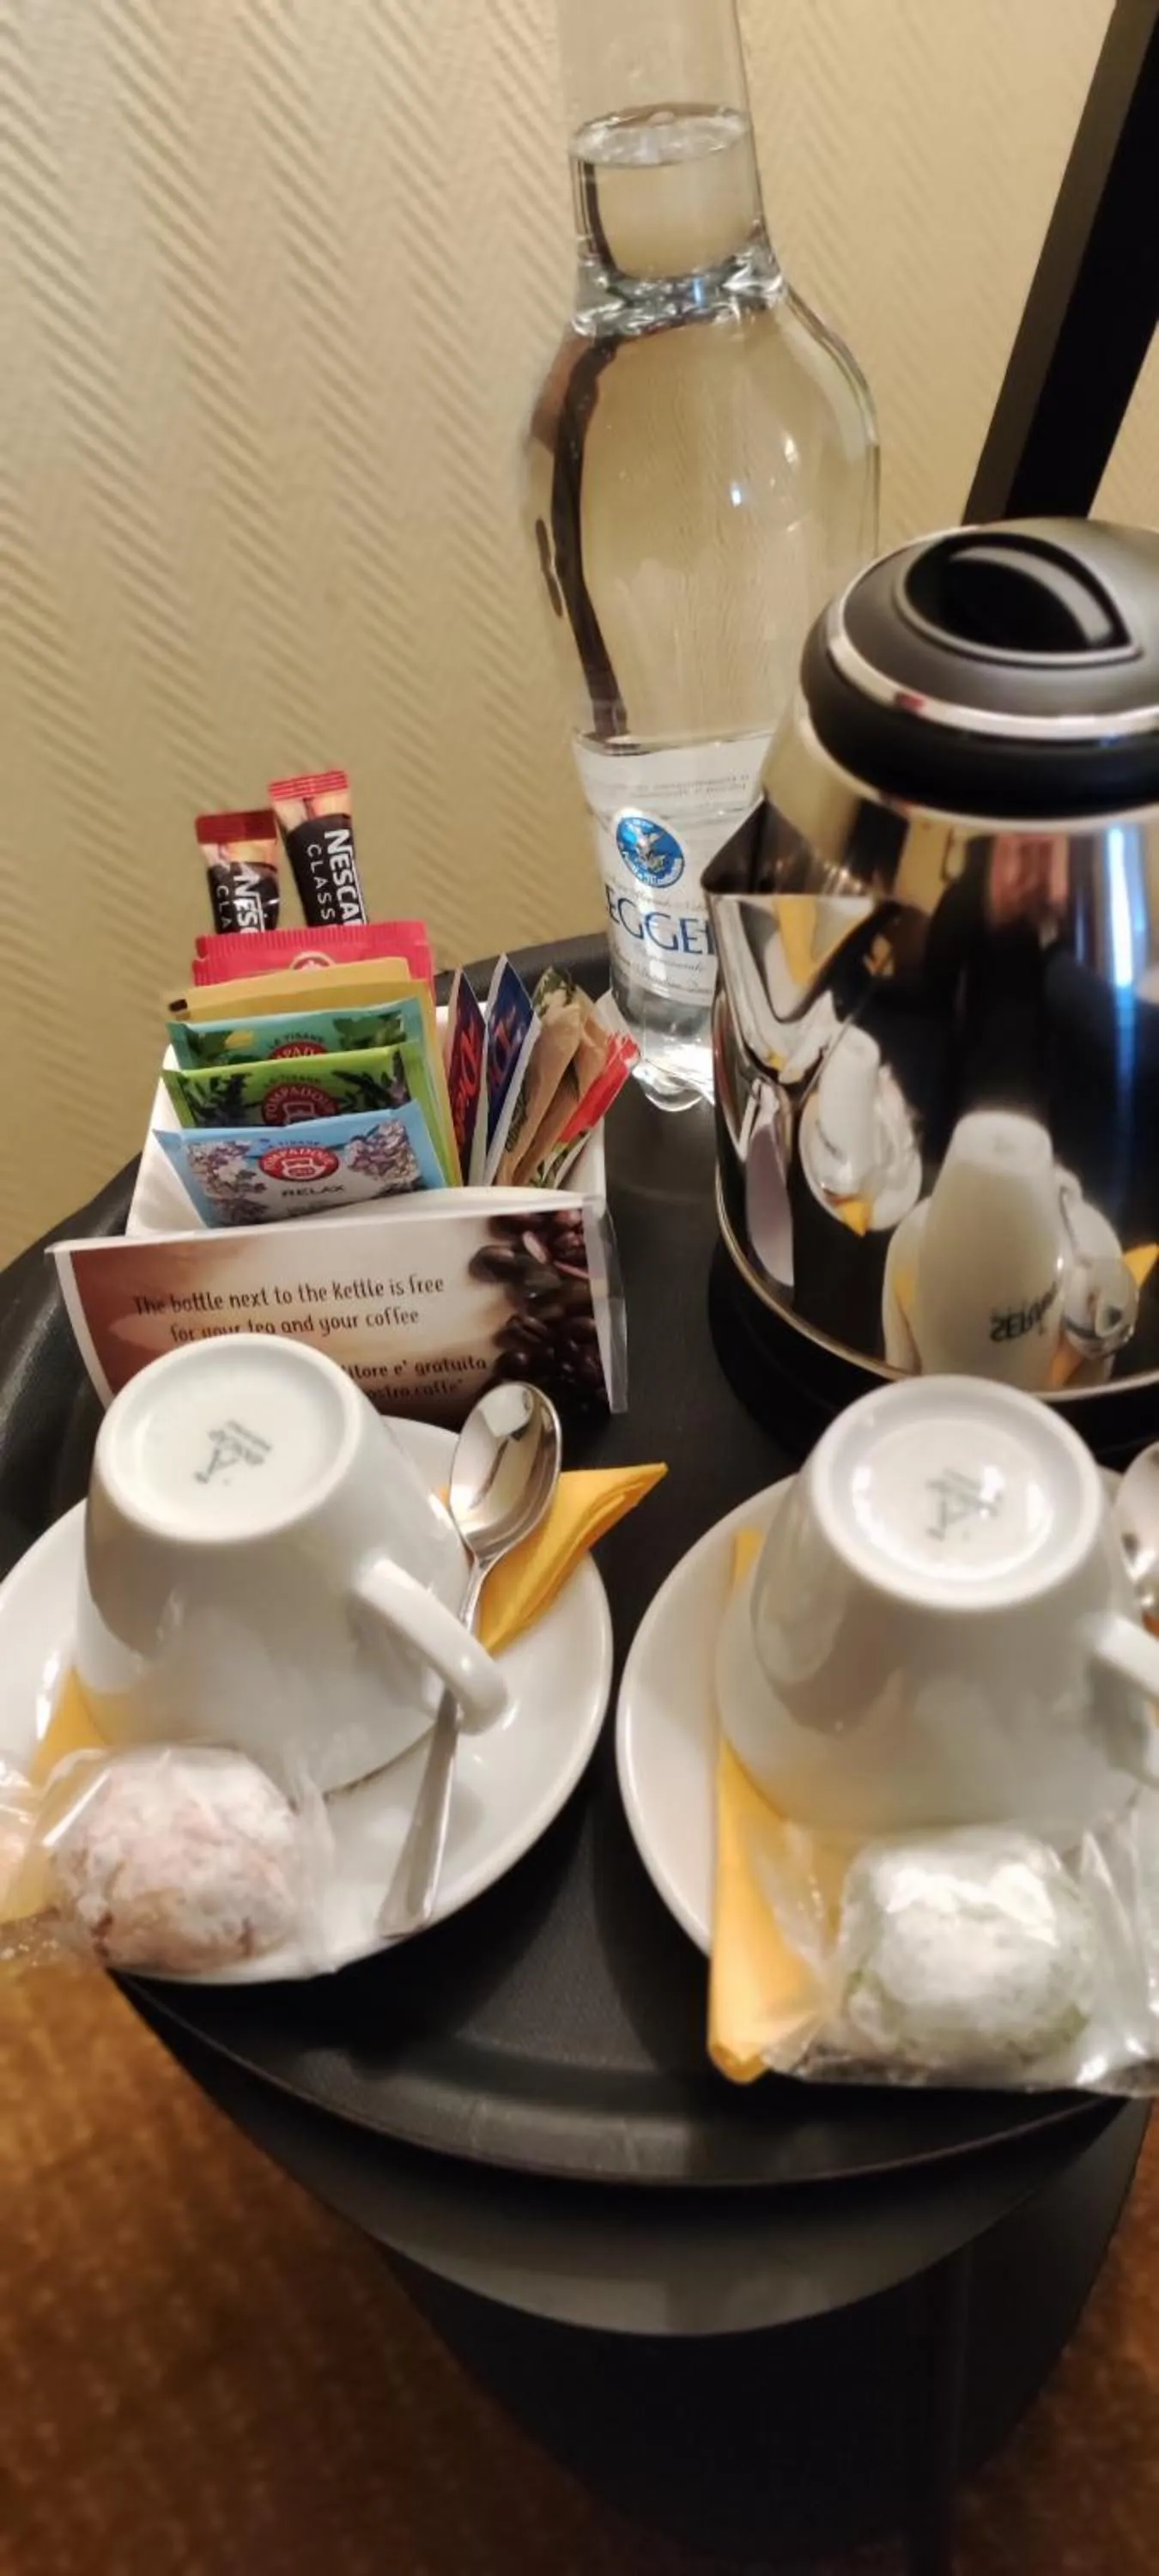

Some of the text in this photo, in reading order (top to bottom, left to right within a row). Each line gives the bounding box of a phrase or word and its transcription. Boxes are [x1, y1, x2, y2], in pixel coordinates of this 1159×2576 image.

[281, 1185, 345, 1197] RELAX
[132, 1294, 165, 1315] The
[169, 1291, 223, 1313] bottle
[229, 1286, 269, 1309] next
[274, 1285, 293, 1305] to
[298, 1282, 328, 1303] the
[389, 1277, 405, 1297] is
[408, 1273, 445, 1294] free
[169, 1322, 196, 1344] for
[247, 1318, 276, 1334] tea
[281, 1314, 315, 1334] and
[319, 1315, 359, 1337] your
[365, 1305, 420, 1327] coffee
[414, 1355, 488, 1376] gratuita
[367, 1386, 410, 1400] ostro
